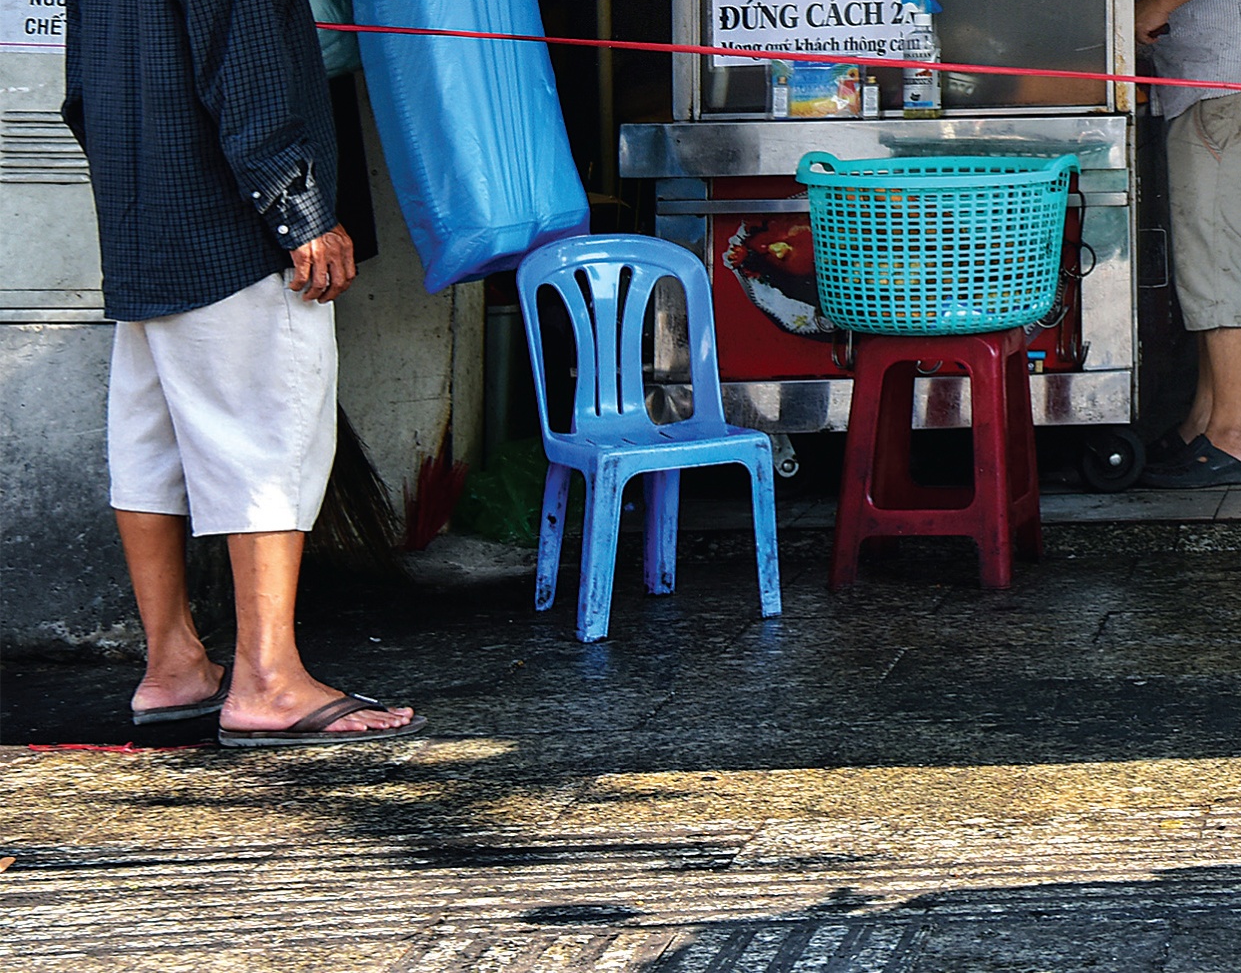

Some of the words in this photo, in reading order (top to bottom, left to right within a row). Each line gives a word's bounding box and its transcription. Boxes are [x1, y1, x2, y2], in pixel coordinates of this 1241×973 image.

[890, 1, 918, 26] 2
[795, 36, 840, 53] khách
[843, 36, 887, 56] thông
